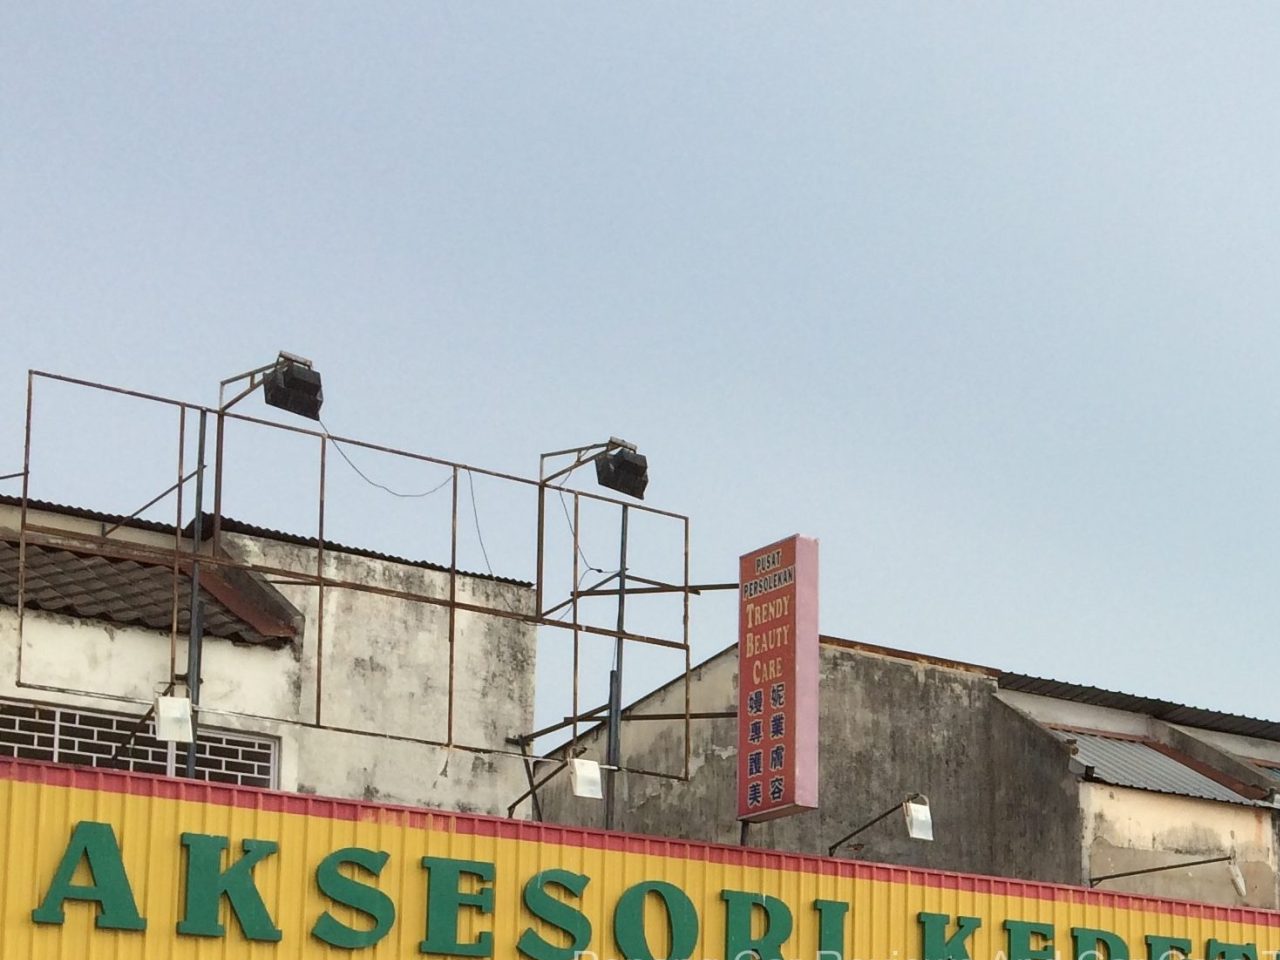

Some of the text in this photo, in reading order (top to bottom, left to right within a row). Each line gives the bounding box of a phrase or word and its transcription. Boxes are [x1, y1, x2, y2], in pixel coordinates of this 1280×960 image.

[755, 550, 781, 573] PUSAT
[743, 566, 794, 598] PERSOLEKAN
[746, 595, 790, 629] TRENDY
[746, 625, 790, 658] BEAUTY
[752, 657, 783, 685] CARE
